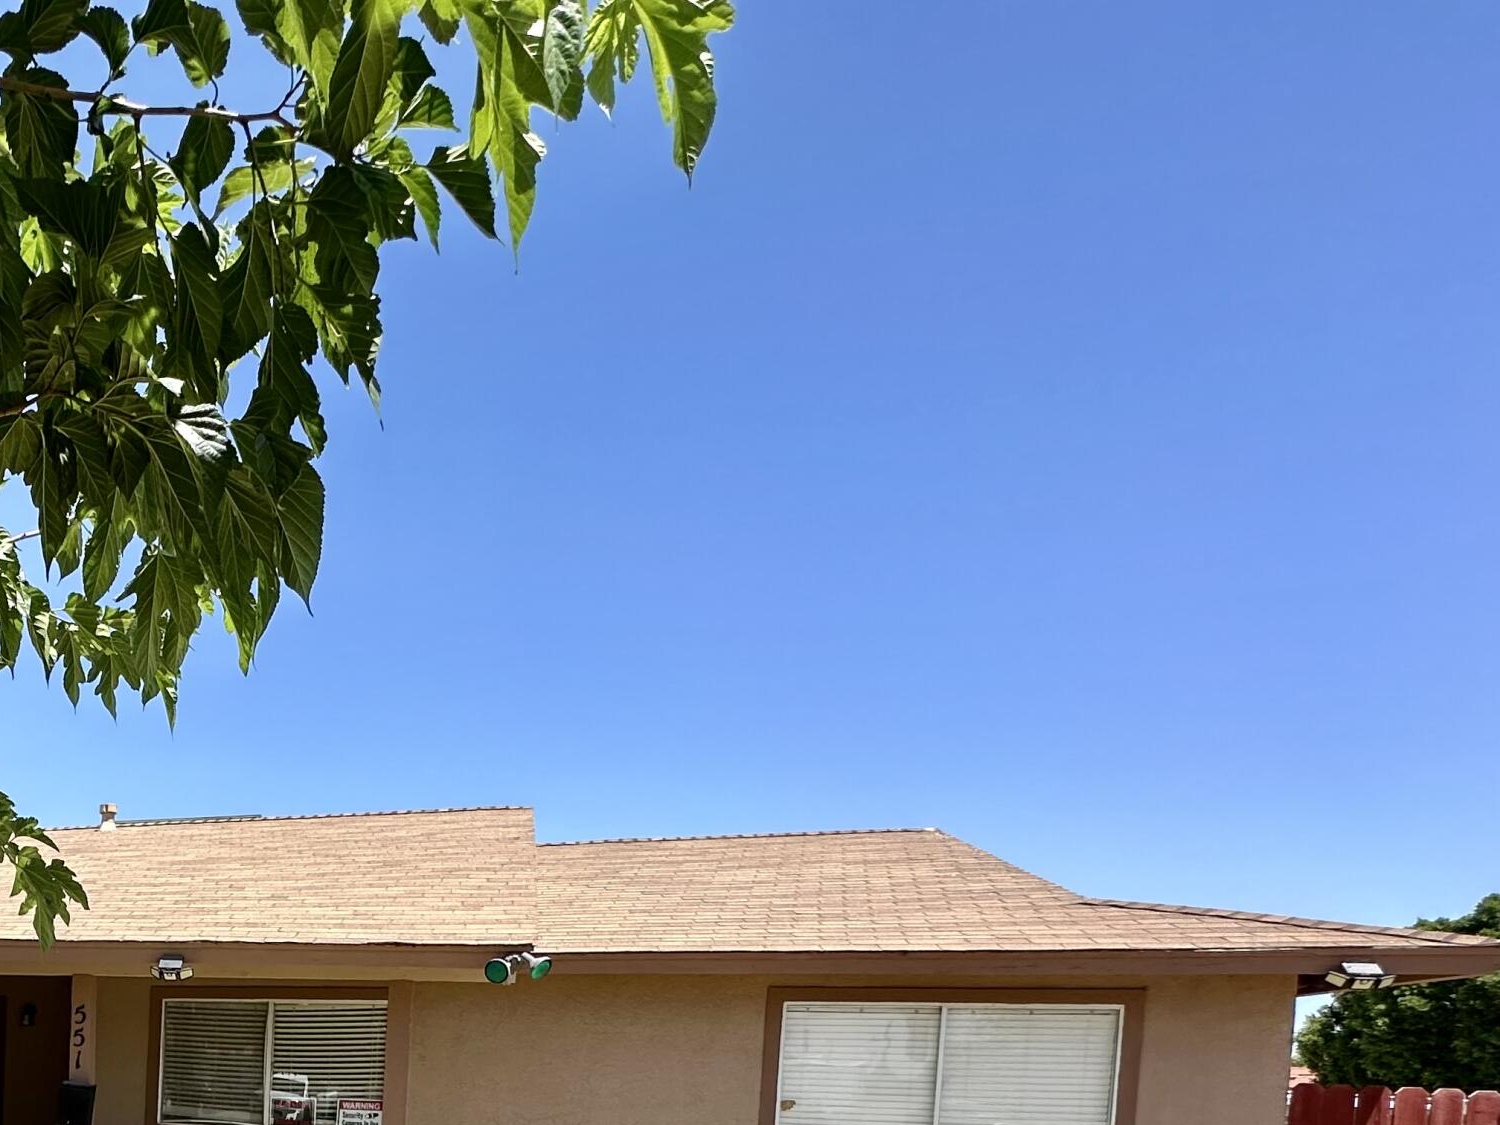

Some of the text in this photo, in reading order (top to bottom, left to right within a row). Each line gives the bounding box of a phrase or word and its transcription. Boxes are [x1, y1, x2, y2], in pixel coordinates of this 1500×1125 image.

[73, 1004, 87, 1069] 551
[342, 1101, 381, 1110] WARNING
[342, 1111, 364, 1120] Security
